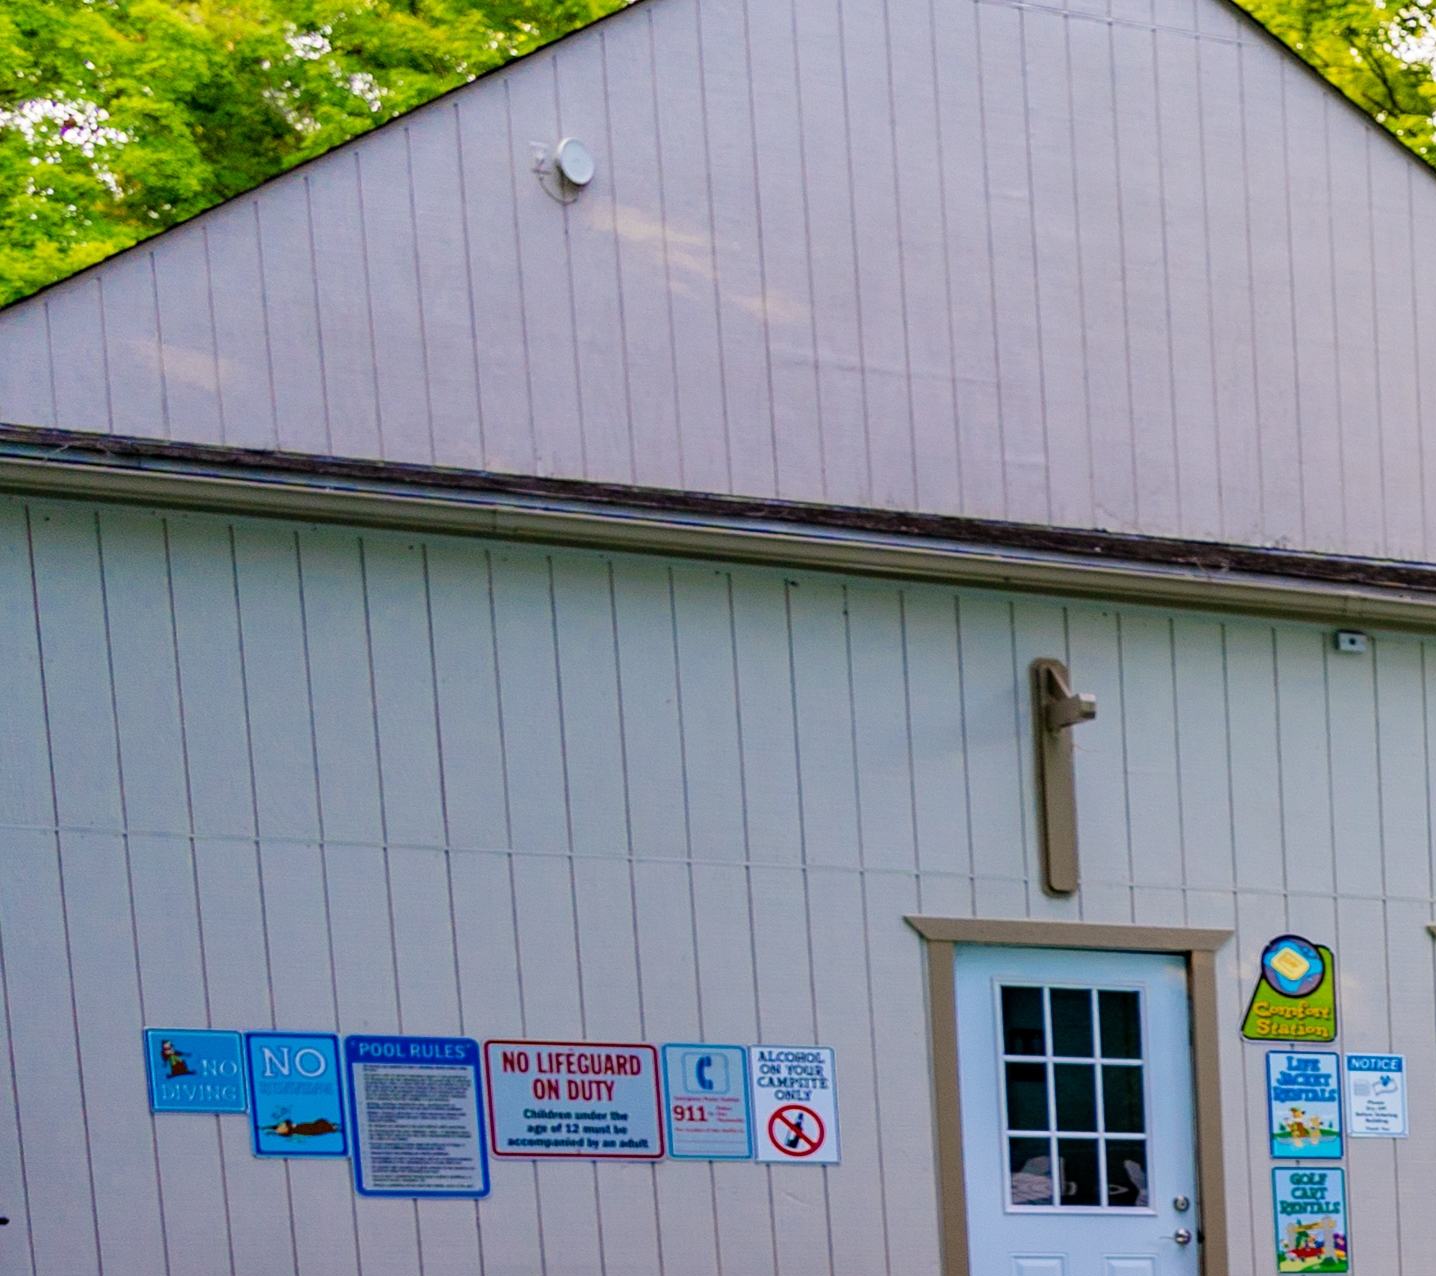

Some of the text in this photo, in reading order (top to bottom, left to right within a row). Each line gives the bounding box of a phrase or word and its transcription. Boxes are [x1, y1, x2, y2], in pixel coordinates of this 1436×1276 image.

[1253, 1000, 1331, 1020] Comfort
[1257, 1019, 1329, 1038] Station
[359, 1042, 466, 1059] POOL RULES
[758, 1050, 826, 1063] ALCOHOL
[202, 1059, 237, 1077] NO
[262, 1047, 326, 1077] NO
[502, 1051, 642, 1076] NO LIFEGUARD
[1351, 1058, 1399, 1070] NOTICE
[759, 1063, 824, 1077] ON YOUR
[757, 1076, 829, 1090] CAMPSITE
[1276, 1071, 1332, 1087] JACKET
[162, 1085, 236, 1101] DIVING
[533, 1078, 615, 1102] ON DUTY
[774, 1089, 812, 1101] ONLY
[1273, 1086, 1337, 1103] RENTALS
[523, 1108, 629, 1122] Children under the
[673, 1105, 707, 1122] 911
[527, 1123, 628, 1135] age of 12 must be
[508, 1137, 649, 1149] accompanied by an adult
[1290, 1172, 1328, 1186] GOLF
[1290, 1187, 1328, 1201] CART
[1279, 1200, 1341, 1215] RENTALS
